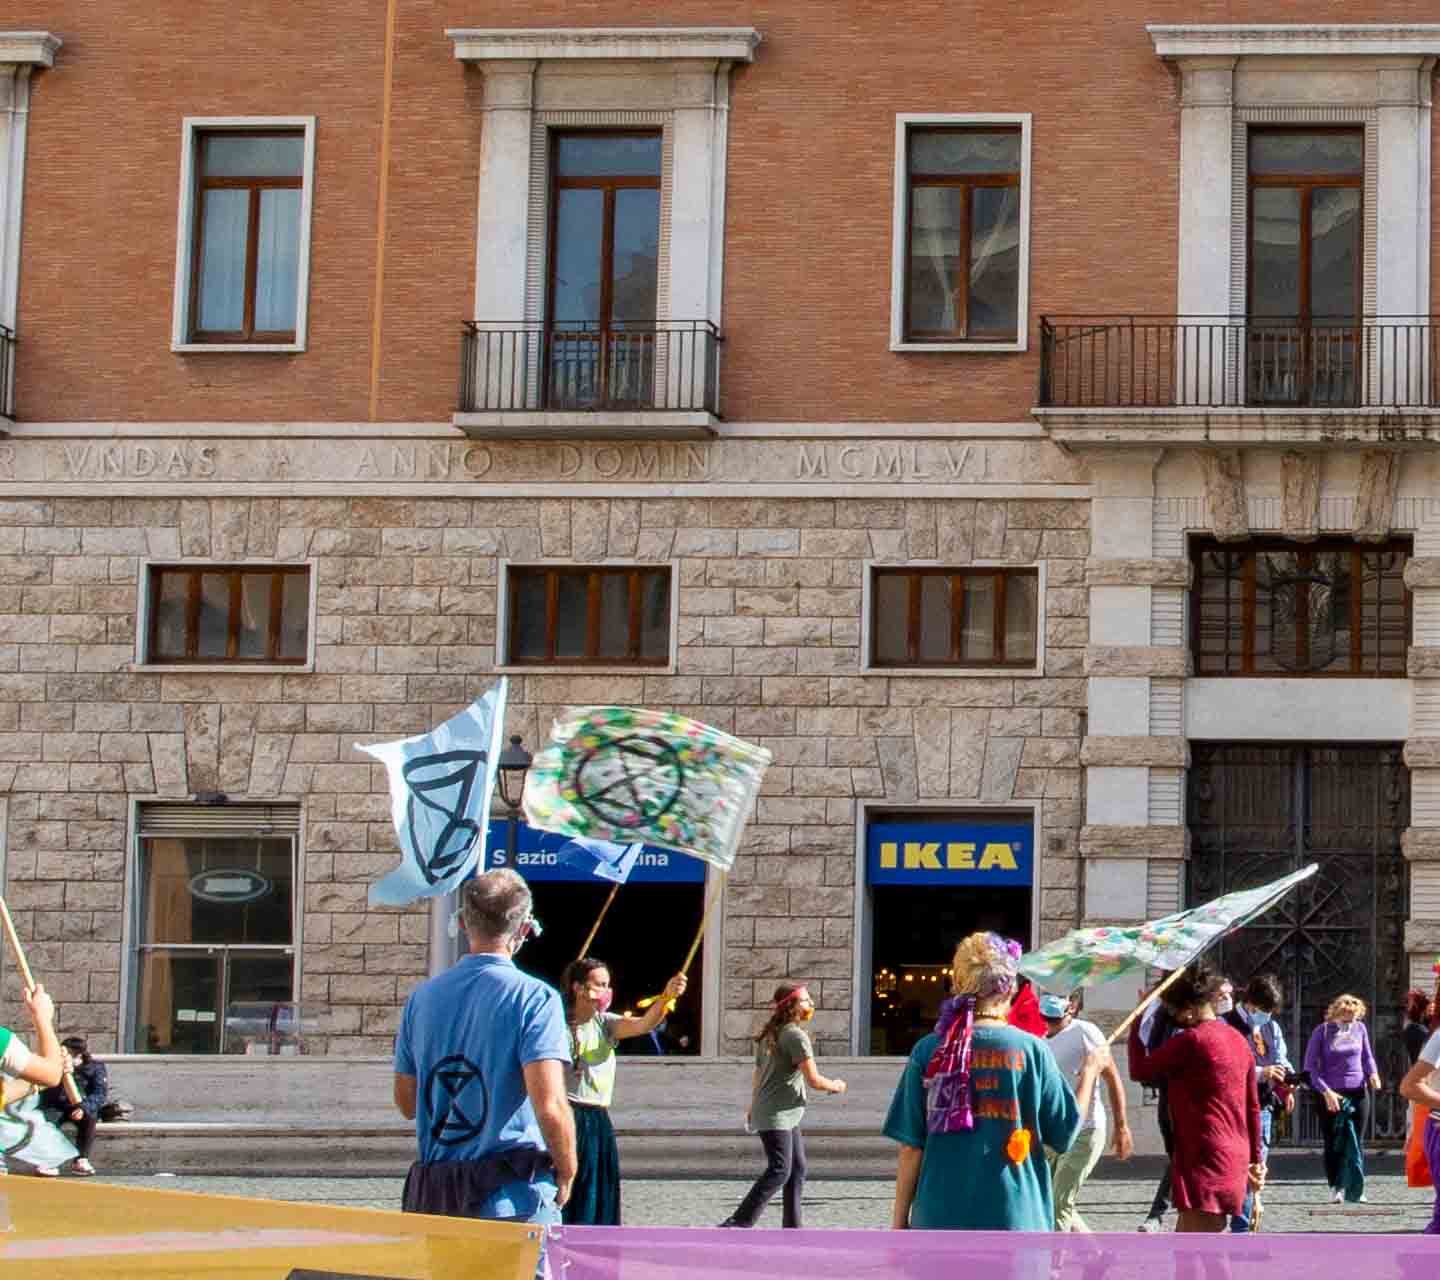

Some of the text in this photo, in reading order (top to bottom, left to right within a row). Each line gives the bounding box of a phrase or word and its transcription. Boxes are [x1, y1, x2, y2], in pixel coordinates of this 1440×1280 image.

[63, 445, 219, 478] VNDAS
[354, 445, 494, 478] ANNO
[795, 446, 993, 479] MCMLVI
[492, 849, 559, 868] Sazio
[880, 842, 1019, 870] IKEA
